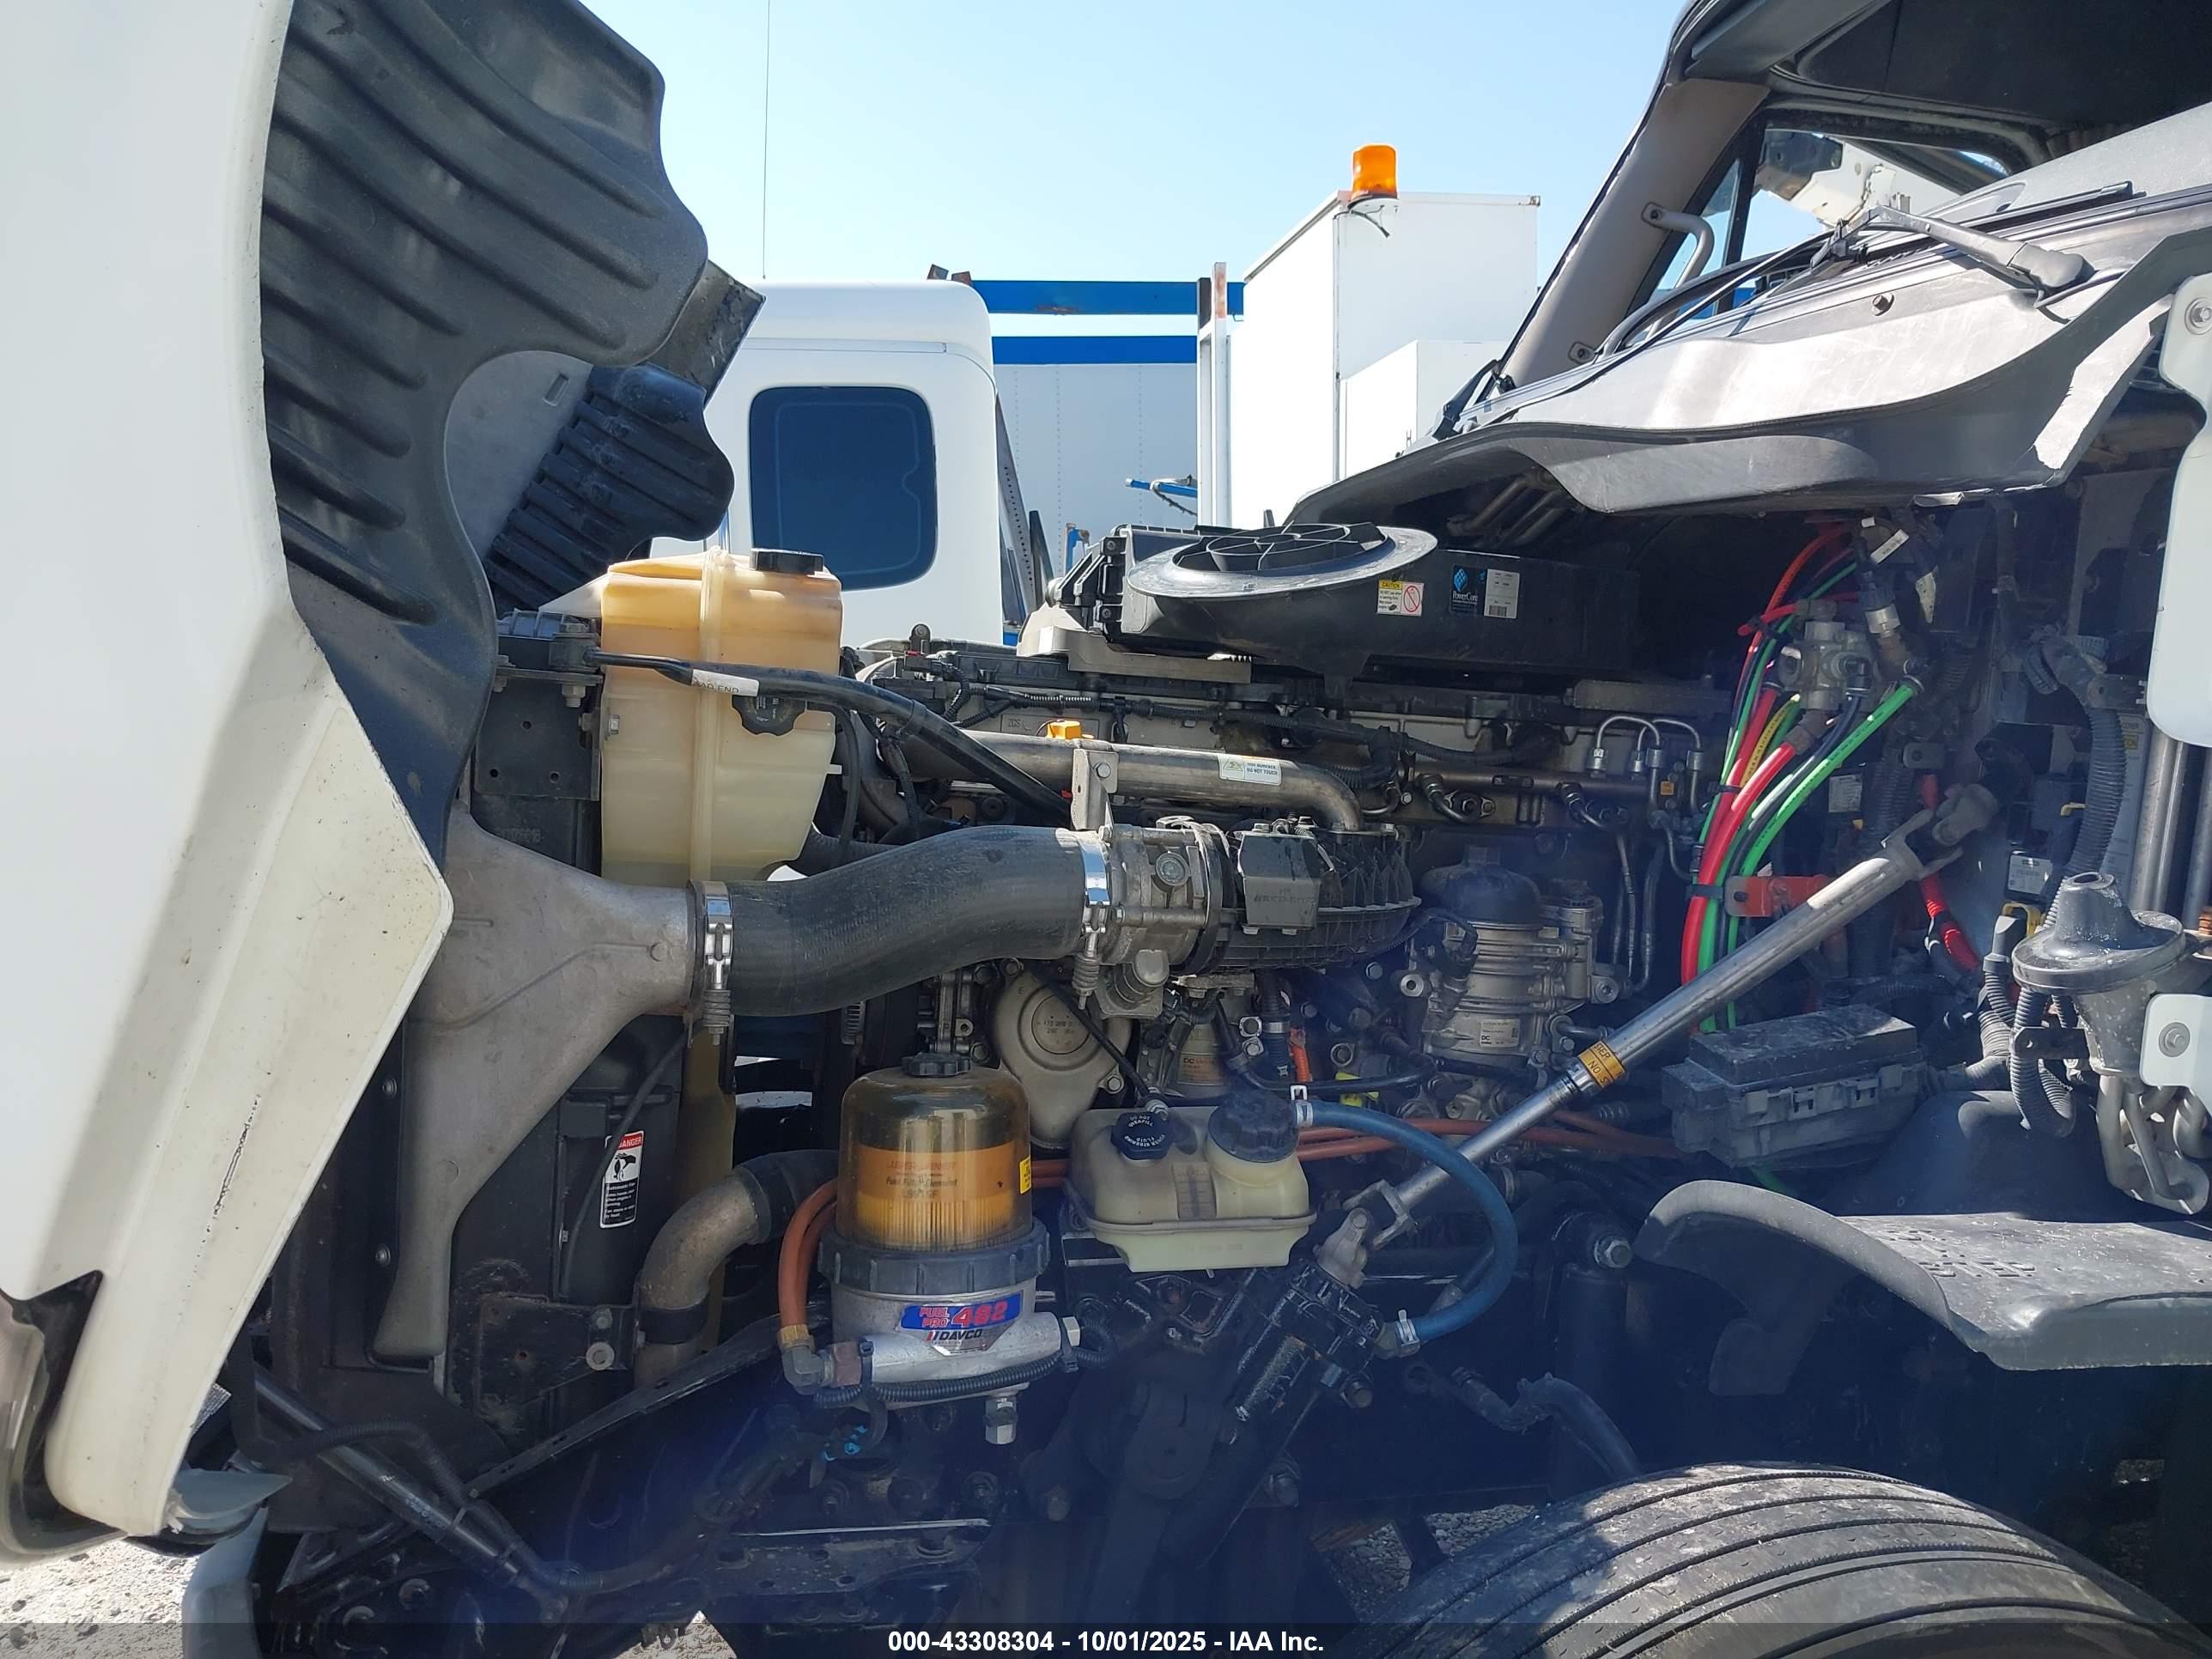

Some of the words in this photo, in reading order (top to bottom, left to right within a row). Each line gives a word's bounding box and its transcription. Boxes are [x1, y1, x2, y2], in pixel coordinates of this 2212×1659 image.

[1452, 590, 1479, 602] PowerCore
[716, 684, 739, 694] END
[1589, 1060, 1601, 1074] NO
[920, 1306, 951, 1318] FUEL
[921, 1317, 950, 1329] PRO
[939, 1328, 984, 1341] DAVCO
